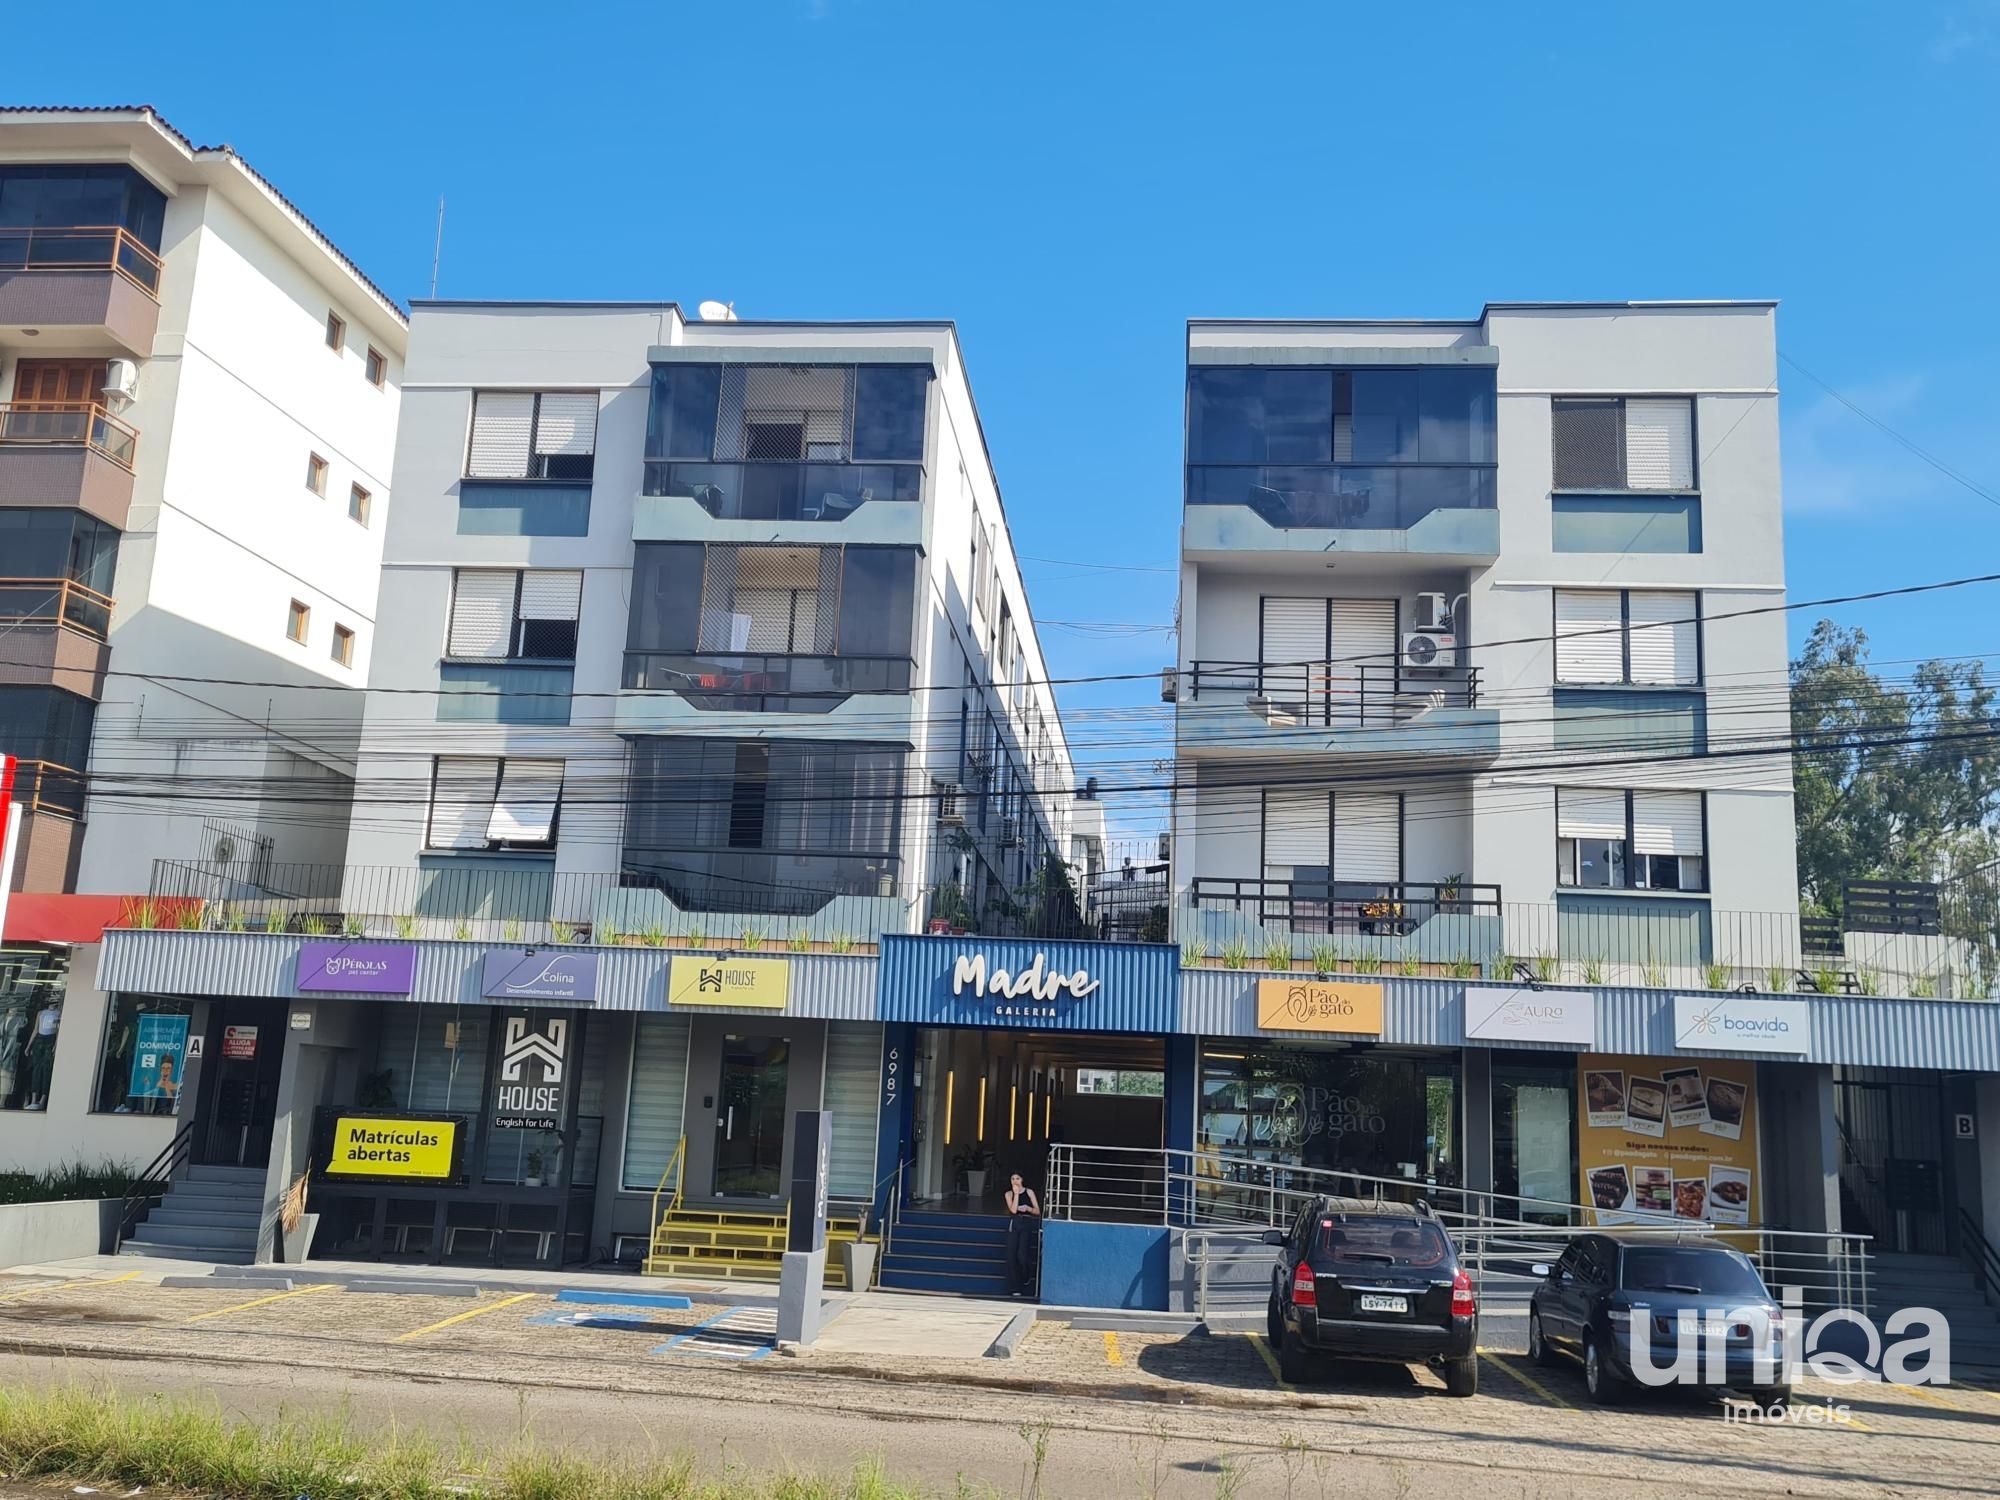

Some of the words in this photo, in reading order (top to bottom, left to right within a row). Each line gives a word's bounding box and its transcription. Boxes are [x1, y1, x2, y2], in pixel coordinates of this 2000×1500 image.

[542, 972, 574, 984] Colina
[725, 970, 756, 986] HOUSE
[953, 953, 1099, 1000] Madre
[1310, 988, 1339, 1004] Pão
[996, 1006, 1056, 1017] GALERIA
[1319, 1003, 1354, 1018] gato
[1724, 1014, 1789, 1032] boavida
[139, 1041, 181, 1051] DOMINGO
[190, 1038, 200, 1054] A
[886, 1047, 898, 1106] 6987
[498, 1086, 559, 1112] HOUSE
[1310, 1087, 1360, 1113] Pão
[496, 1117, 523, 1129] English
[525, 1118, 537, 1128] for
[539, 1119, 554, 1129] Life
[1328, 1112, 1386, 1138] gato
[1959, 1118, 1971, 1134] B
[350, 1129, 438, 1146] Matrículas
[347, 1147, 411, 1162] abertas
